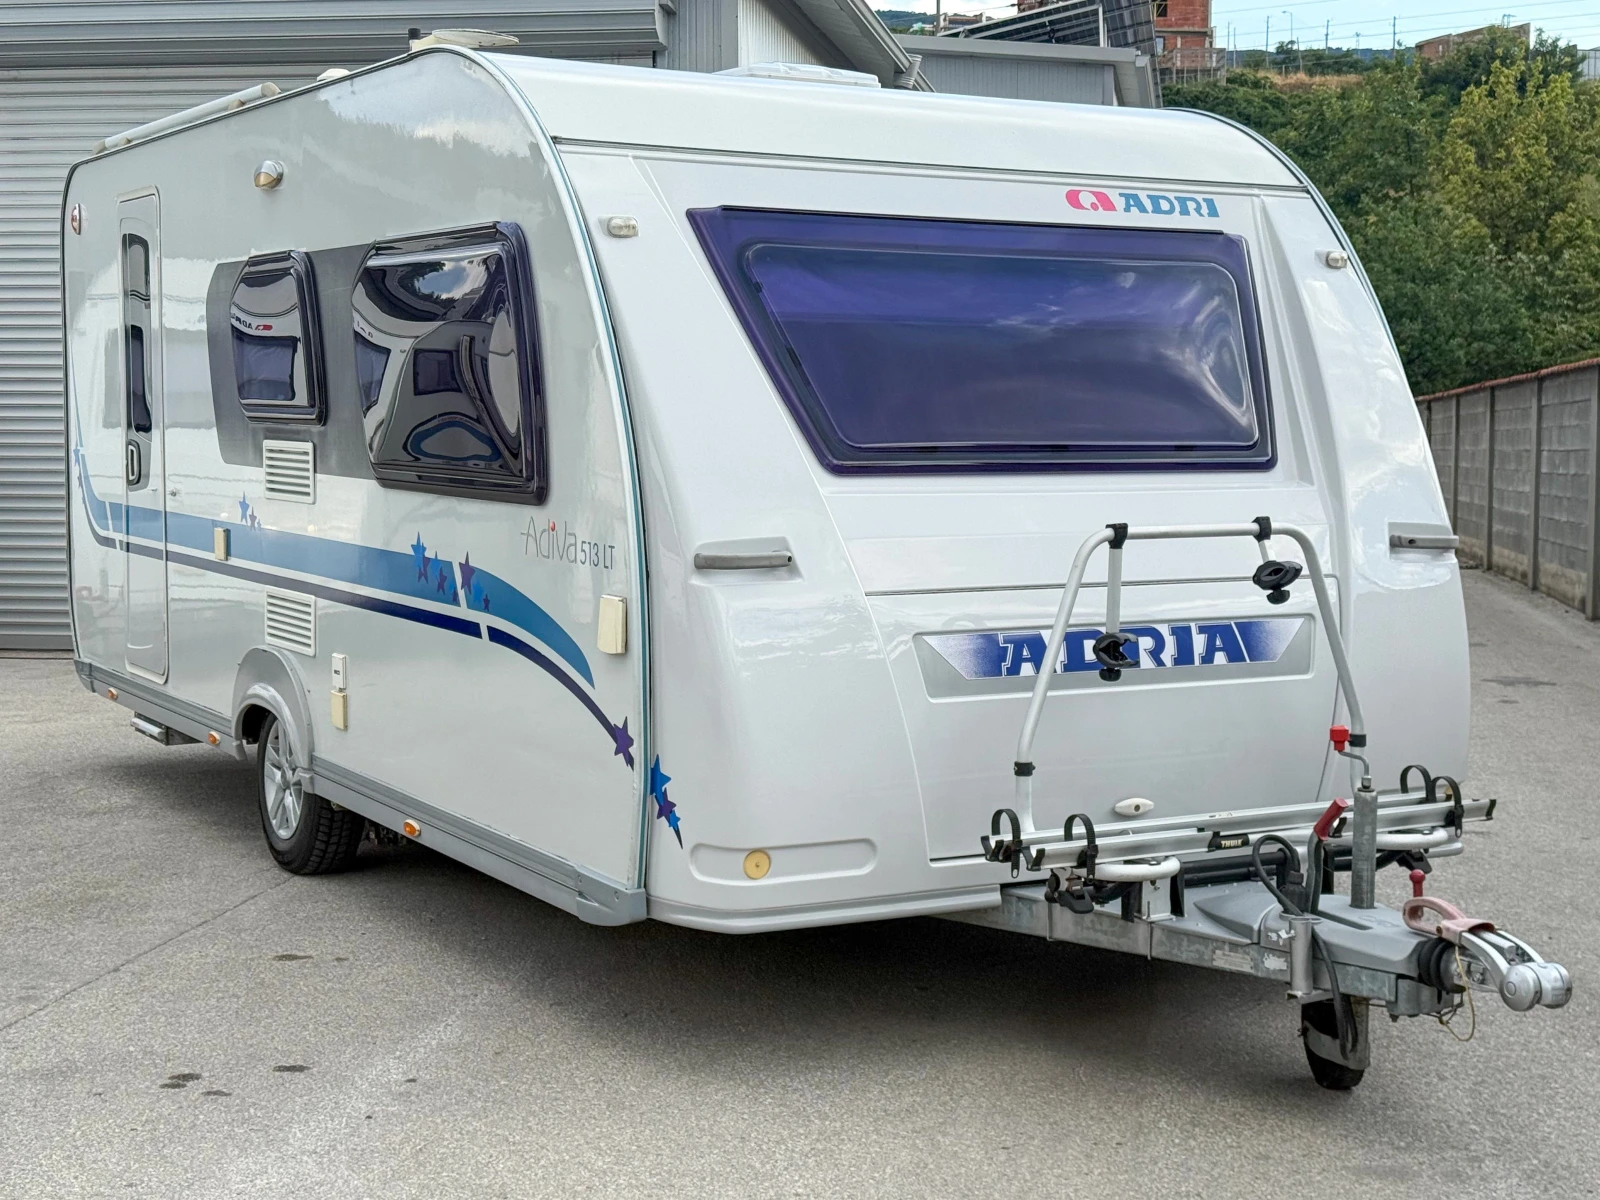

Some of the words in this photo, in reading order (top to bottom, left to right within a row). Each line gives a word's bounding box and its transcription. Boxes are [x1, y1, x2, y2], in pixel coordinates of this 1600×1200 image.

[1118, 192, 1220, 218] ADRI
[580, 540, 600, 567] 513
[603, 544, 615, 570] LT
[1000, 621, 1247, 676] ADRIA
